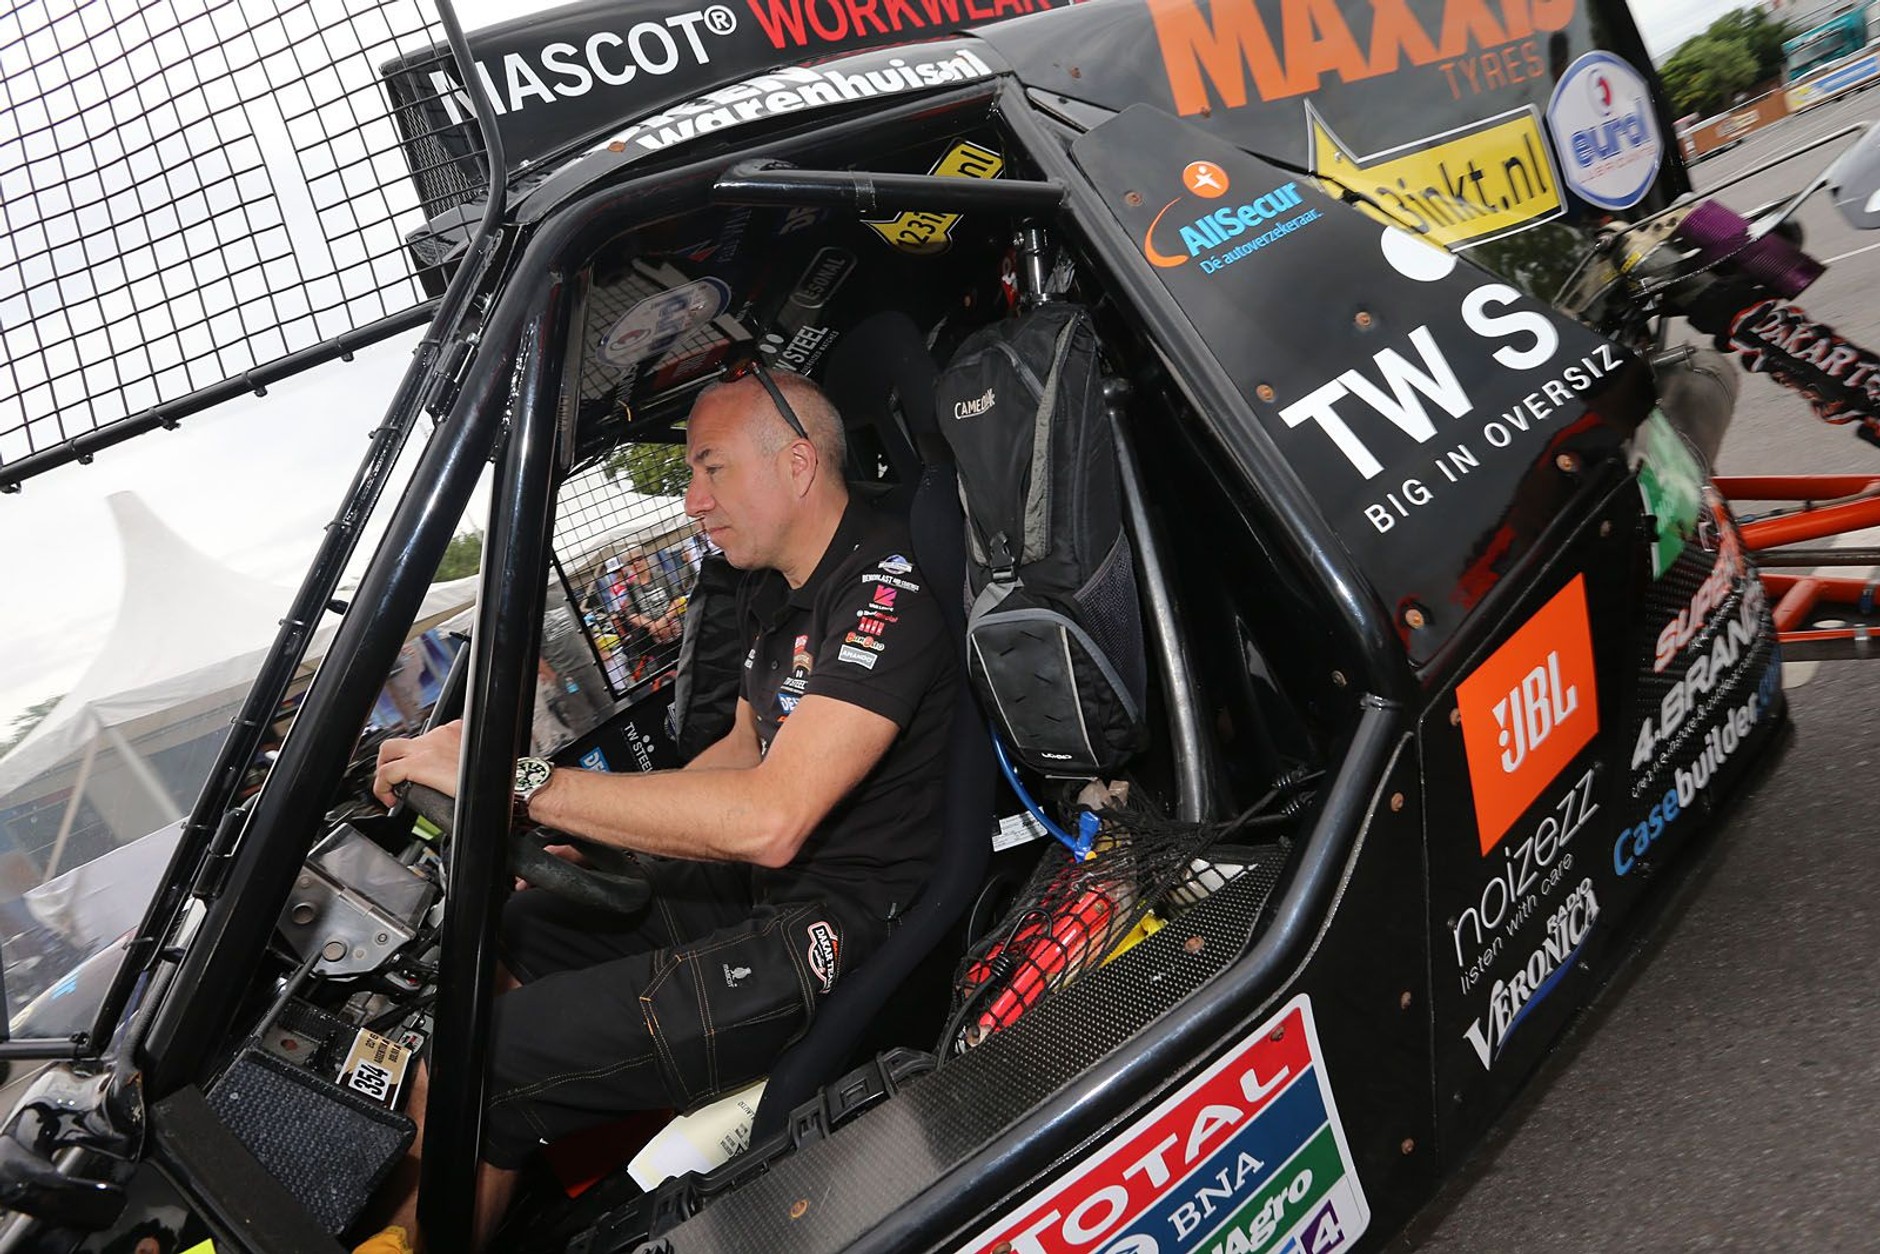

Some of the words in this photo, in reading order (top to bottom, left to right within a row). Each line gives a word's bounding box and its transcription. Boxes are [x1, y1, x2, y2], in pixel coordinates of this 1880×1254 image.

[1147, 0, 1576, 116] MAXX
[1439, 40, 1544, 102] TYRES
[1178, 181, 1304, 258] AllSecur
[1200, 253, 1222, 276] Dé
[788, 325, 829, 365] STEEL
[1363, 479, 1434, 534] BIG
[1435, 444, 1482, 482] IN
[624, 722, 638, 742] TW
[1493, 651, 1578, 774] JBL
[1452, 768, 1600, 967] noizezz
[1547, 877, 1593, 934] RADIO
[816, 928, 833, 962] DAKAR
[1461, 936, 1504, 995] listen
[1506, 894, 1537, 936] with
[1542, 853, 1574, 896] care
[1463, 889, 1601, 1071] VERONICA
[354, 1064, 388, 1096] 354
[1005, 1064, 1291, 1254] TOTAL
[1167, 1151, 1264, 1242] BNA
